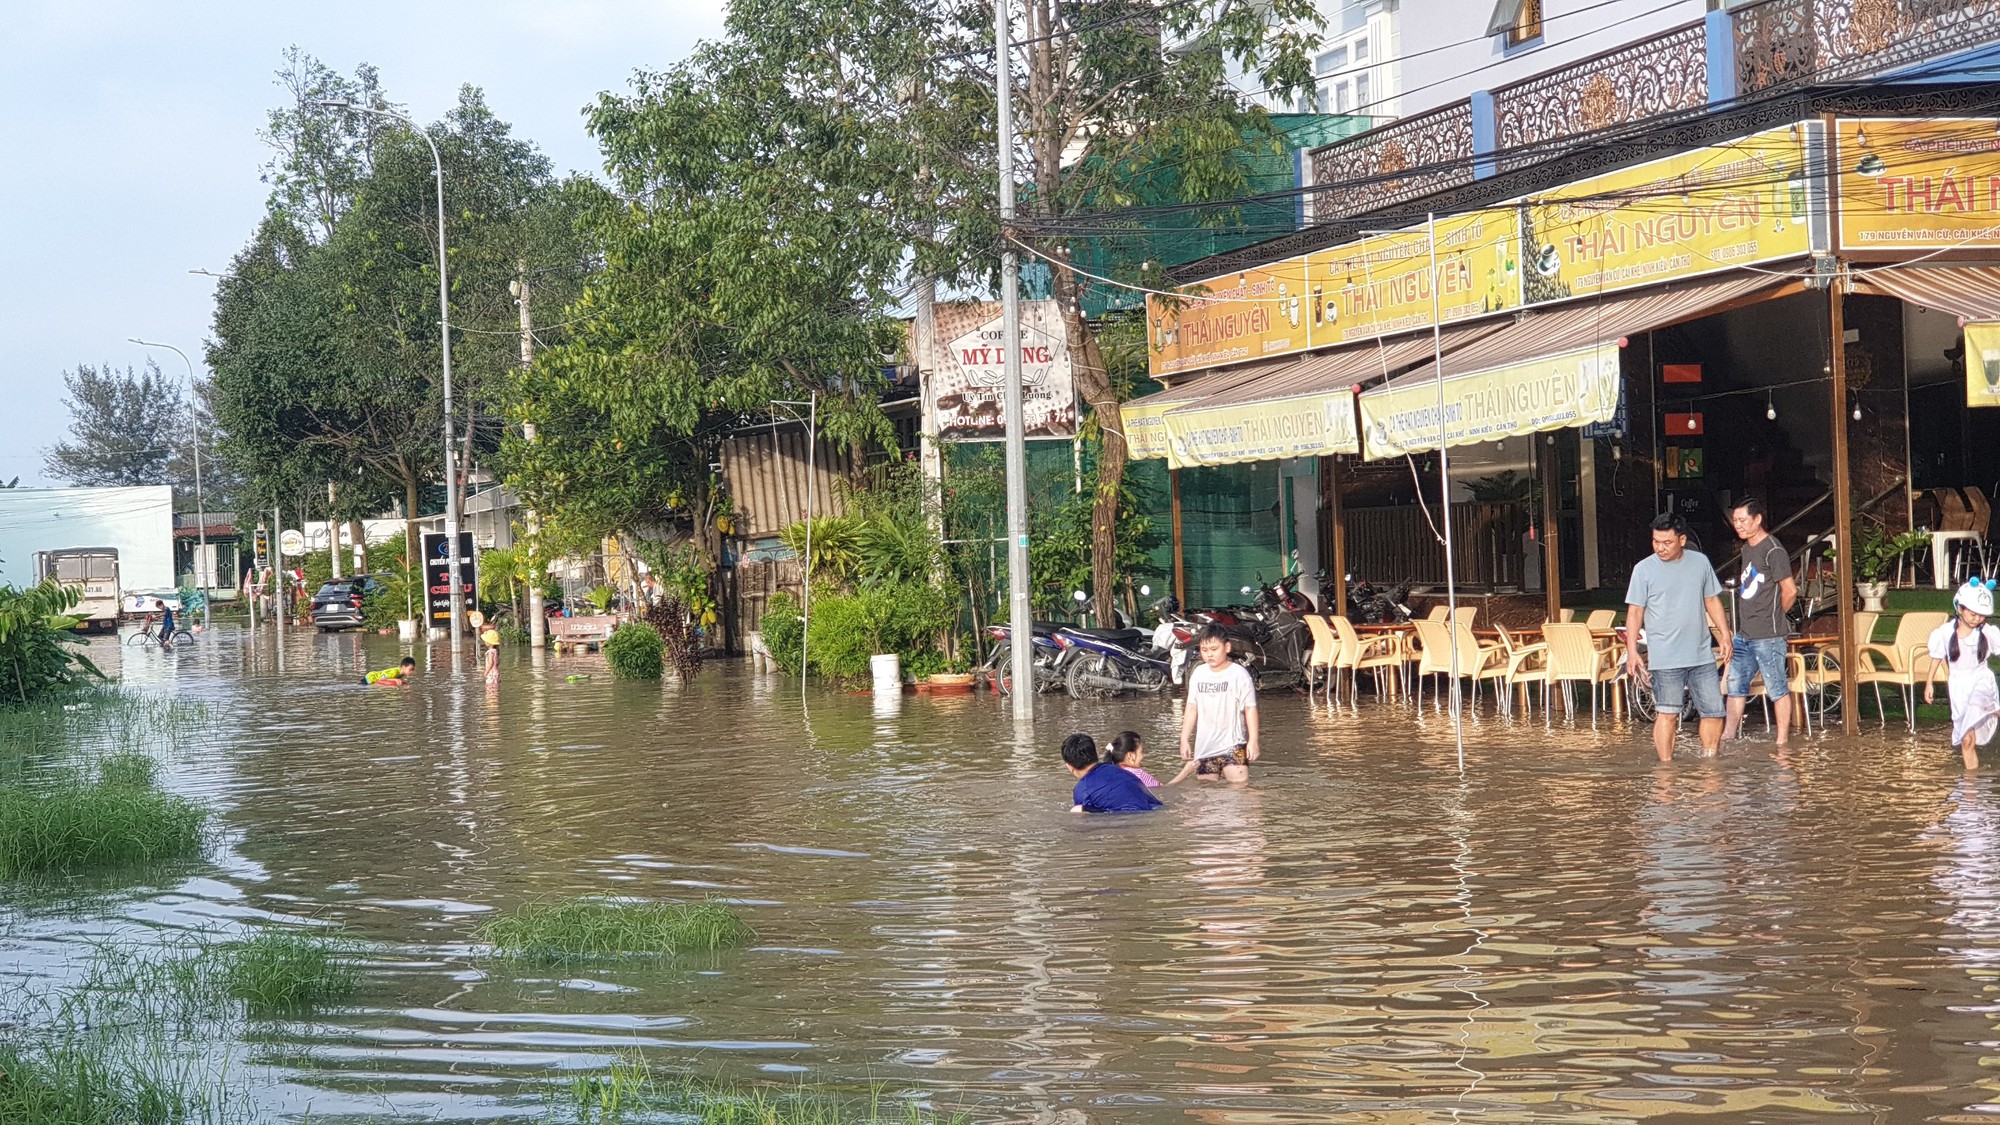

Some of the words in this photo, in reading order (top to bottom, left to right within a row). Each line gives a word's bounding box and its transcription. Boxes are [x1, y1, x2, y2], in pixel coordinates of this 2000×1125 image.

[1877, 166, 1975, 213] THÁI
[1445, 227, 1468, 246] SINH
[1563, 220, 1626, 265] THÁI
[1633, 192, 1761, 251] NGUYÊN
[1859, 231, 1876, 241] 179
[1341, 271, 1384, 317] THÁI
[1389, 253, 1473, 307] NGUYÊN
[981, 330, 1028, 340] COFE
[1183, 313, 1212, 346] THÁI
[1214, 303, 1270, 342] NGUYÊN
[962, 343, 990, 365] MỸ
[962, 392, 975, 402] Uy
[1464, 382, 1501, 421] THÁI
[1505, 369, 1576, 414] NGUYÊN
[1055, 412, 1066, 422] 72
[1273, 406, 1324, 439] NGUYÊN
